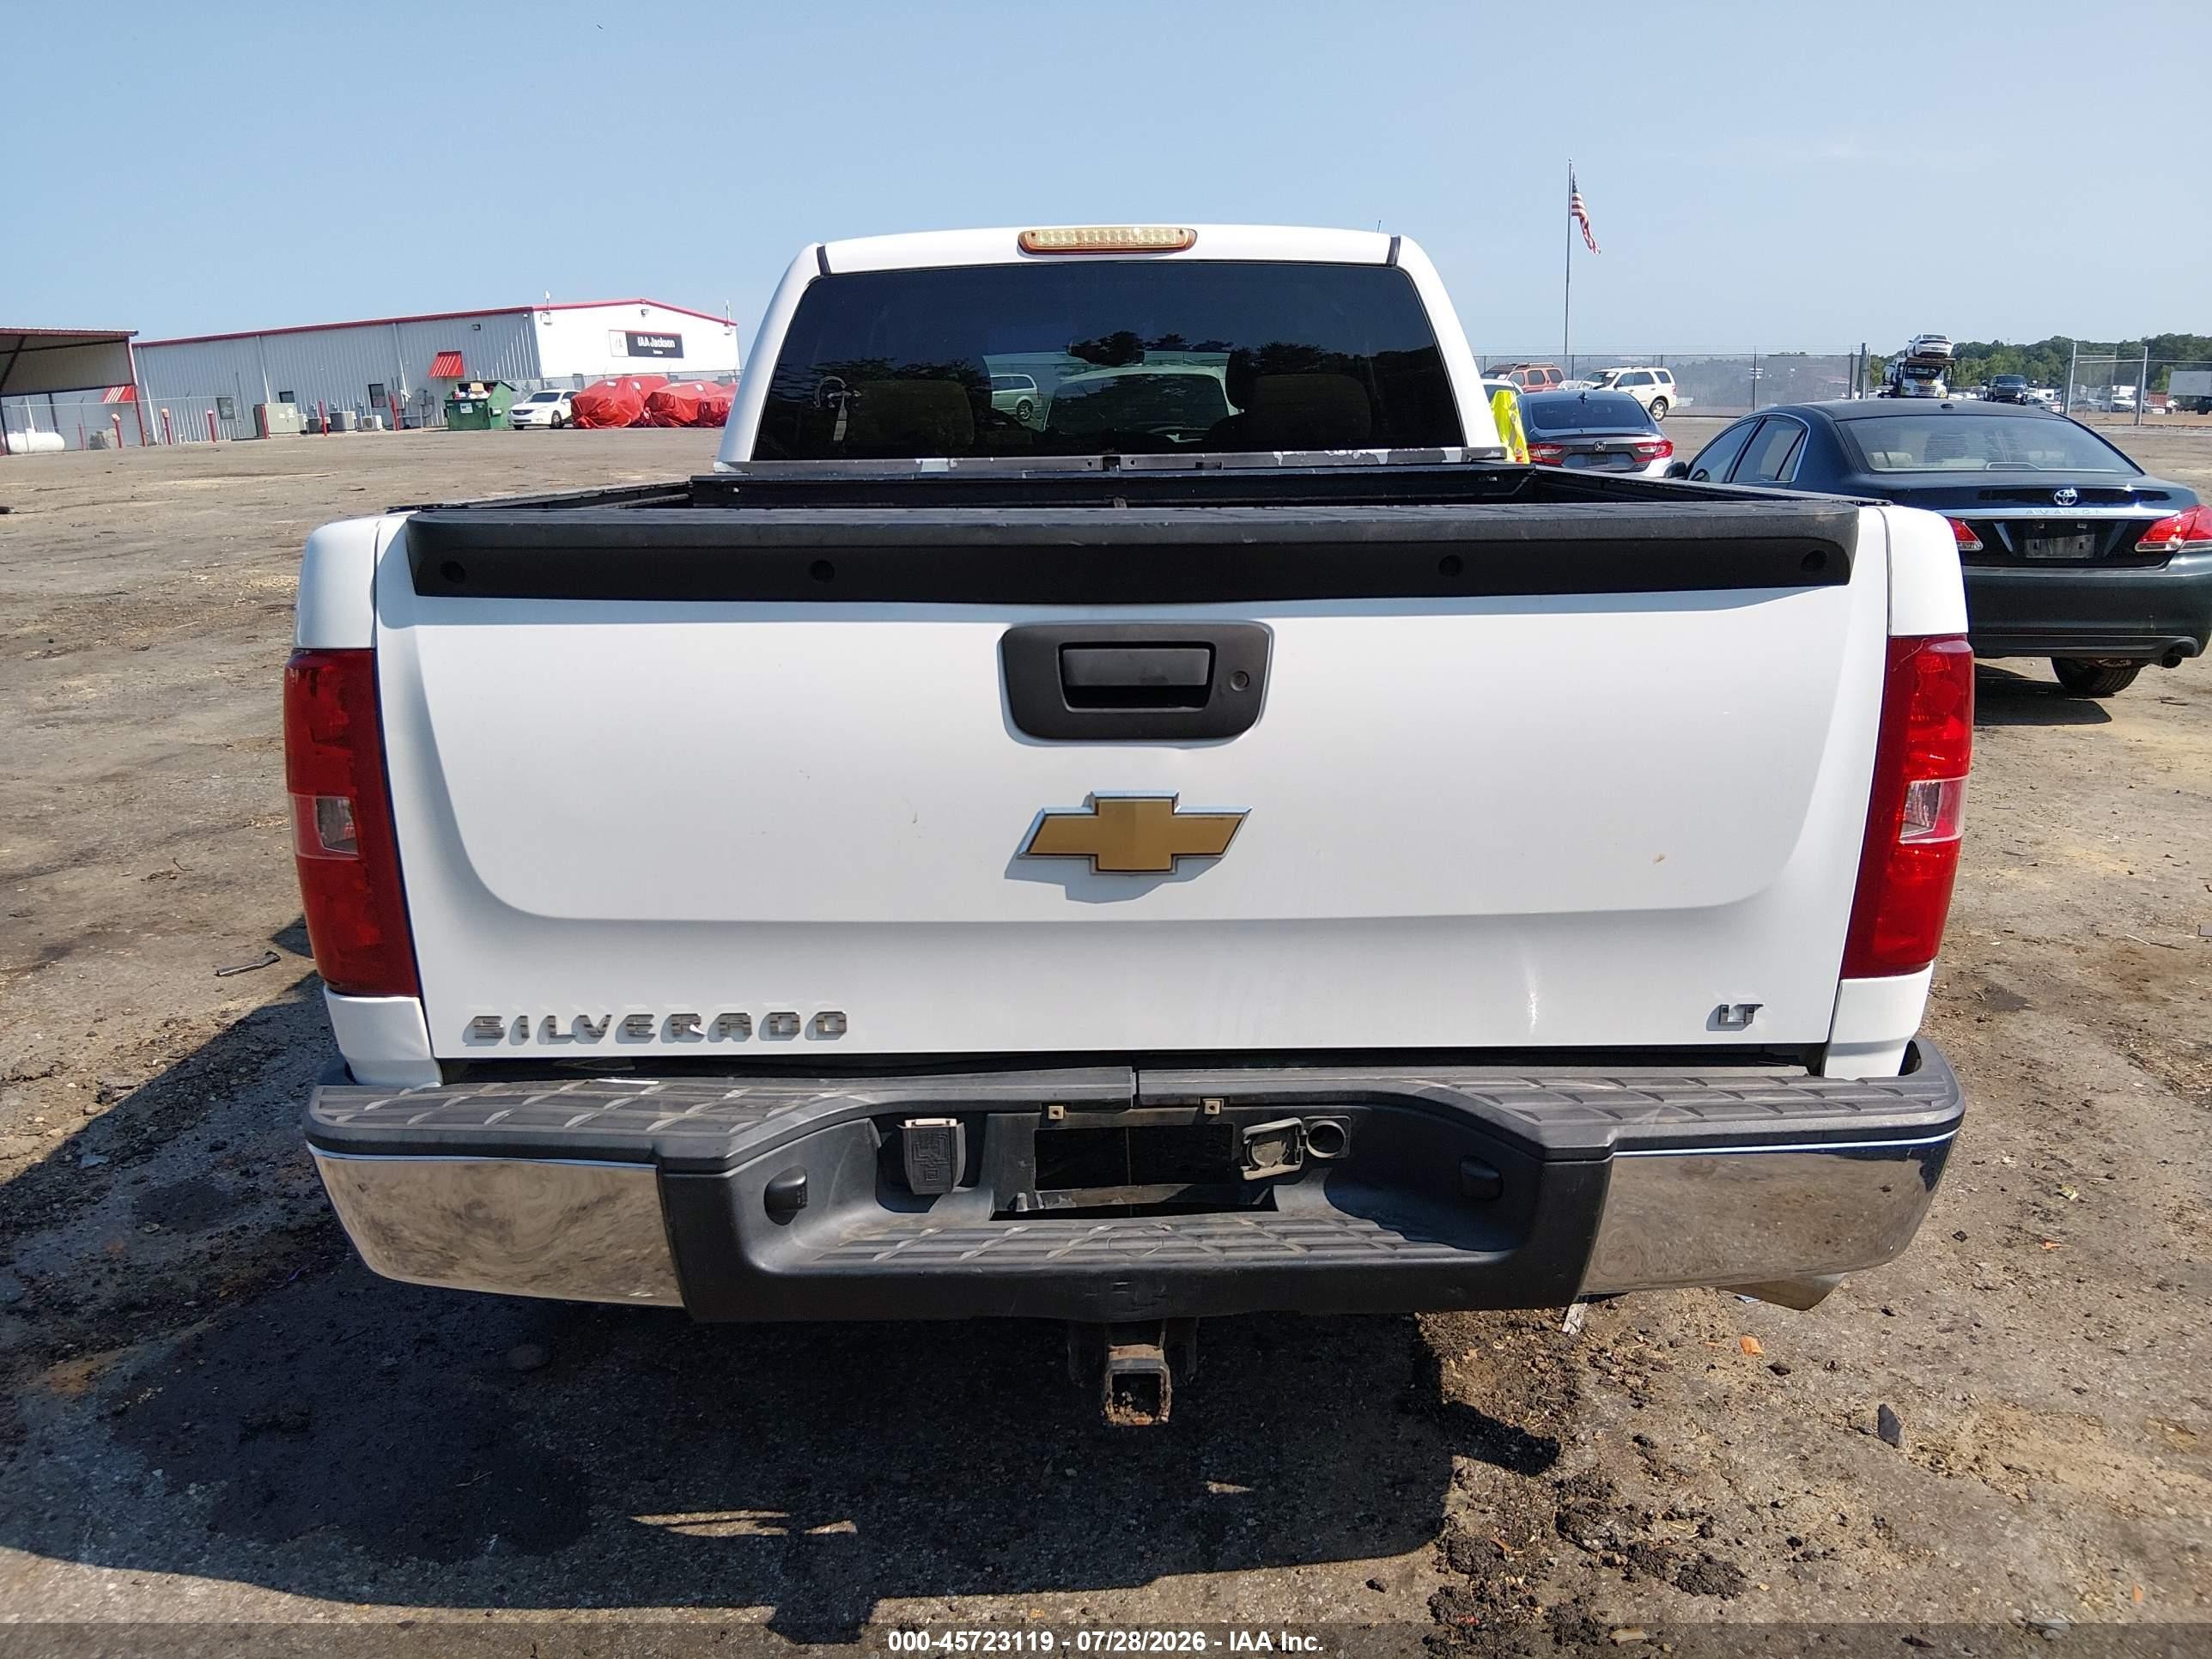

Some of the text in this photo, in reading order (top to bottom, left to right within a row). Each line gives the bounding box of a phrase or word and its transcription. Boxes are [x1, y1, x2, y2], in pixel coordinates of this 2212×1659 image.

[650, 337, 676, 349] Jackson
[1718, 1003, 1764, 1024] LT
[473, 1011, 848, 1040] SILVERADO
